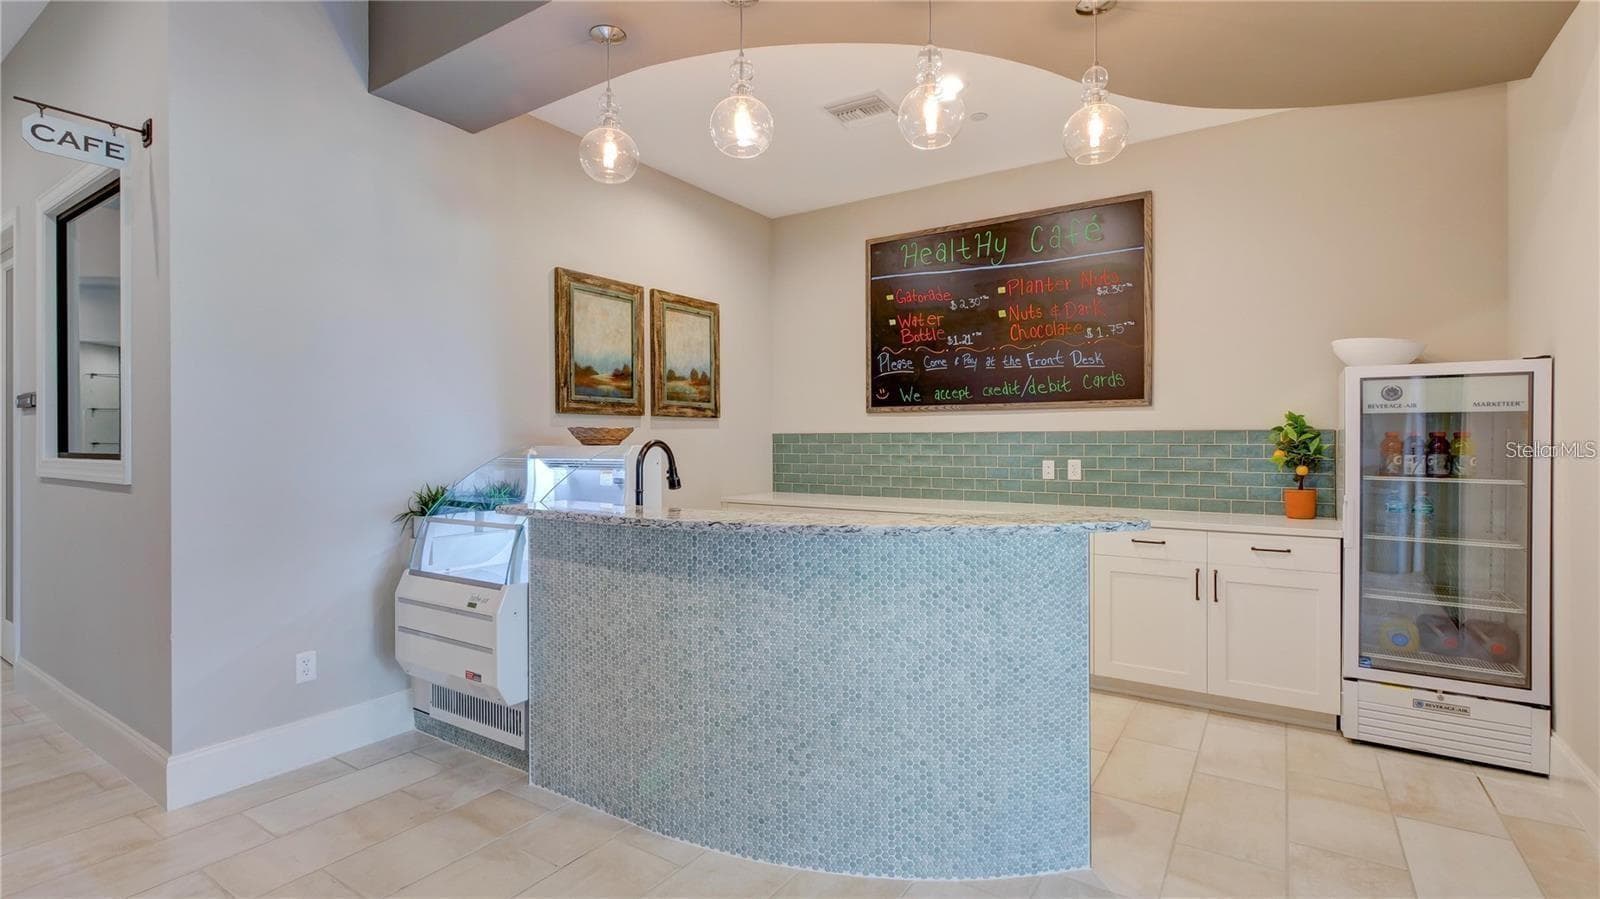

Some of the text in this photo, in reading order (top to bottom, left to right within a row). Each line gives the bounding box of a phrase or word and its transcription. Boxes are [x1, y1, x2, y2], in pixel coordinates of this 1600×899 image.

[30, 123, 125, 161] CAFE
[1030, 213, 1104, 253] Café
[1006, 270, 1120, 296] Planter Nuts
[895, 287, 952, 304] Gatorade
[897, 313, 945, 329] Water
[1008, 303, 1043, 321] Nuts
[900, 328, 946, 345] Bottle
[1010, 321, 1084, 341] Chocolate
[877, 352, 915, 373] Please
[923, 355, 948, 369] Come
[962, 353, 978, 372] Pay
[986, 355, 996, 367] at
[1002, 354, 1022, 367] the
[1026, 350, 1064, 367] Front
[899, 385, 921, 402] We
[934, 386, 974, 401] accept
[1083, 370, 1126, 389] Cards
